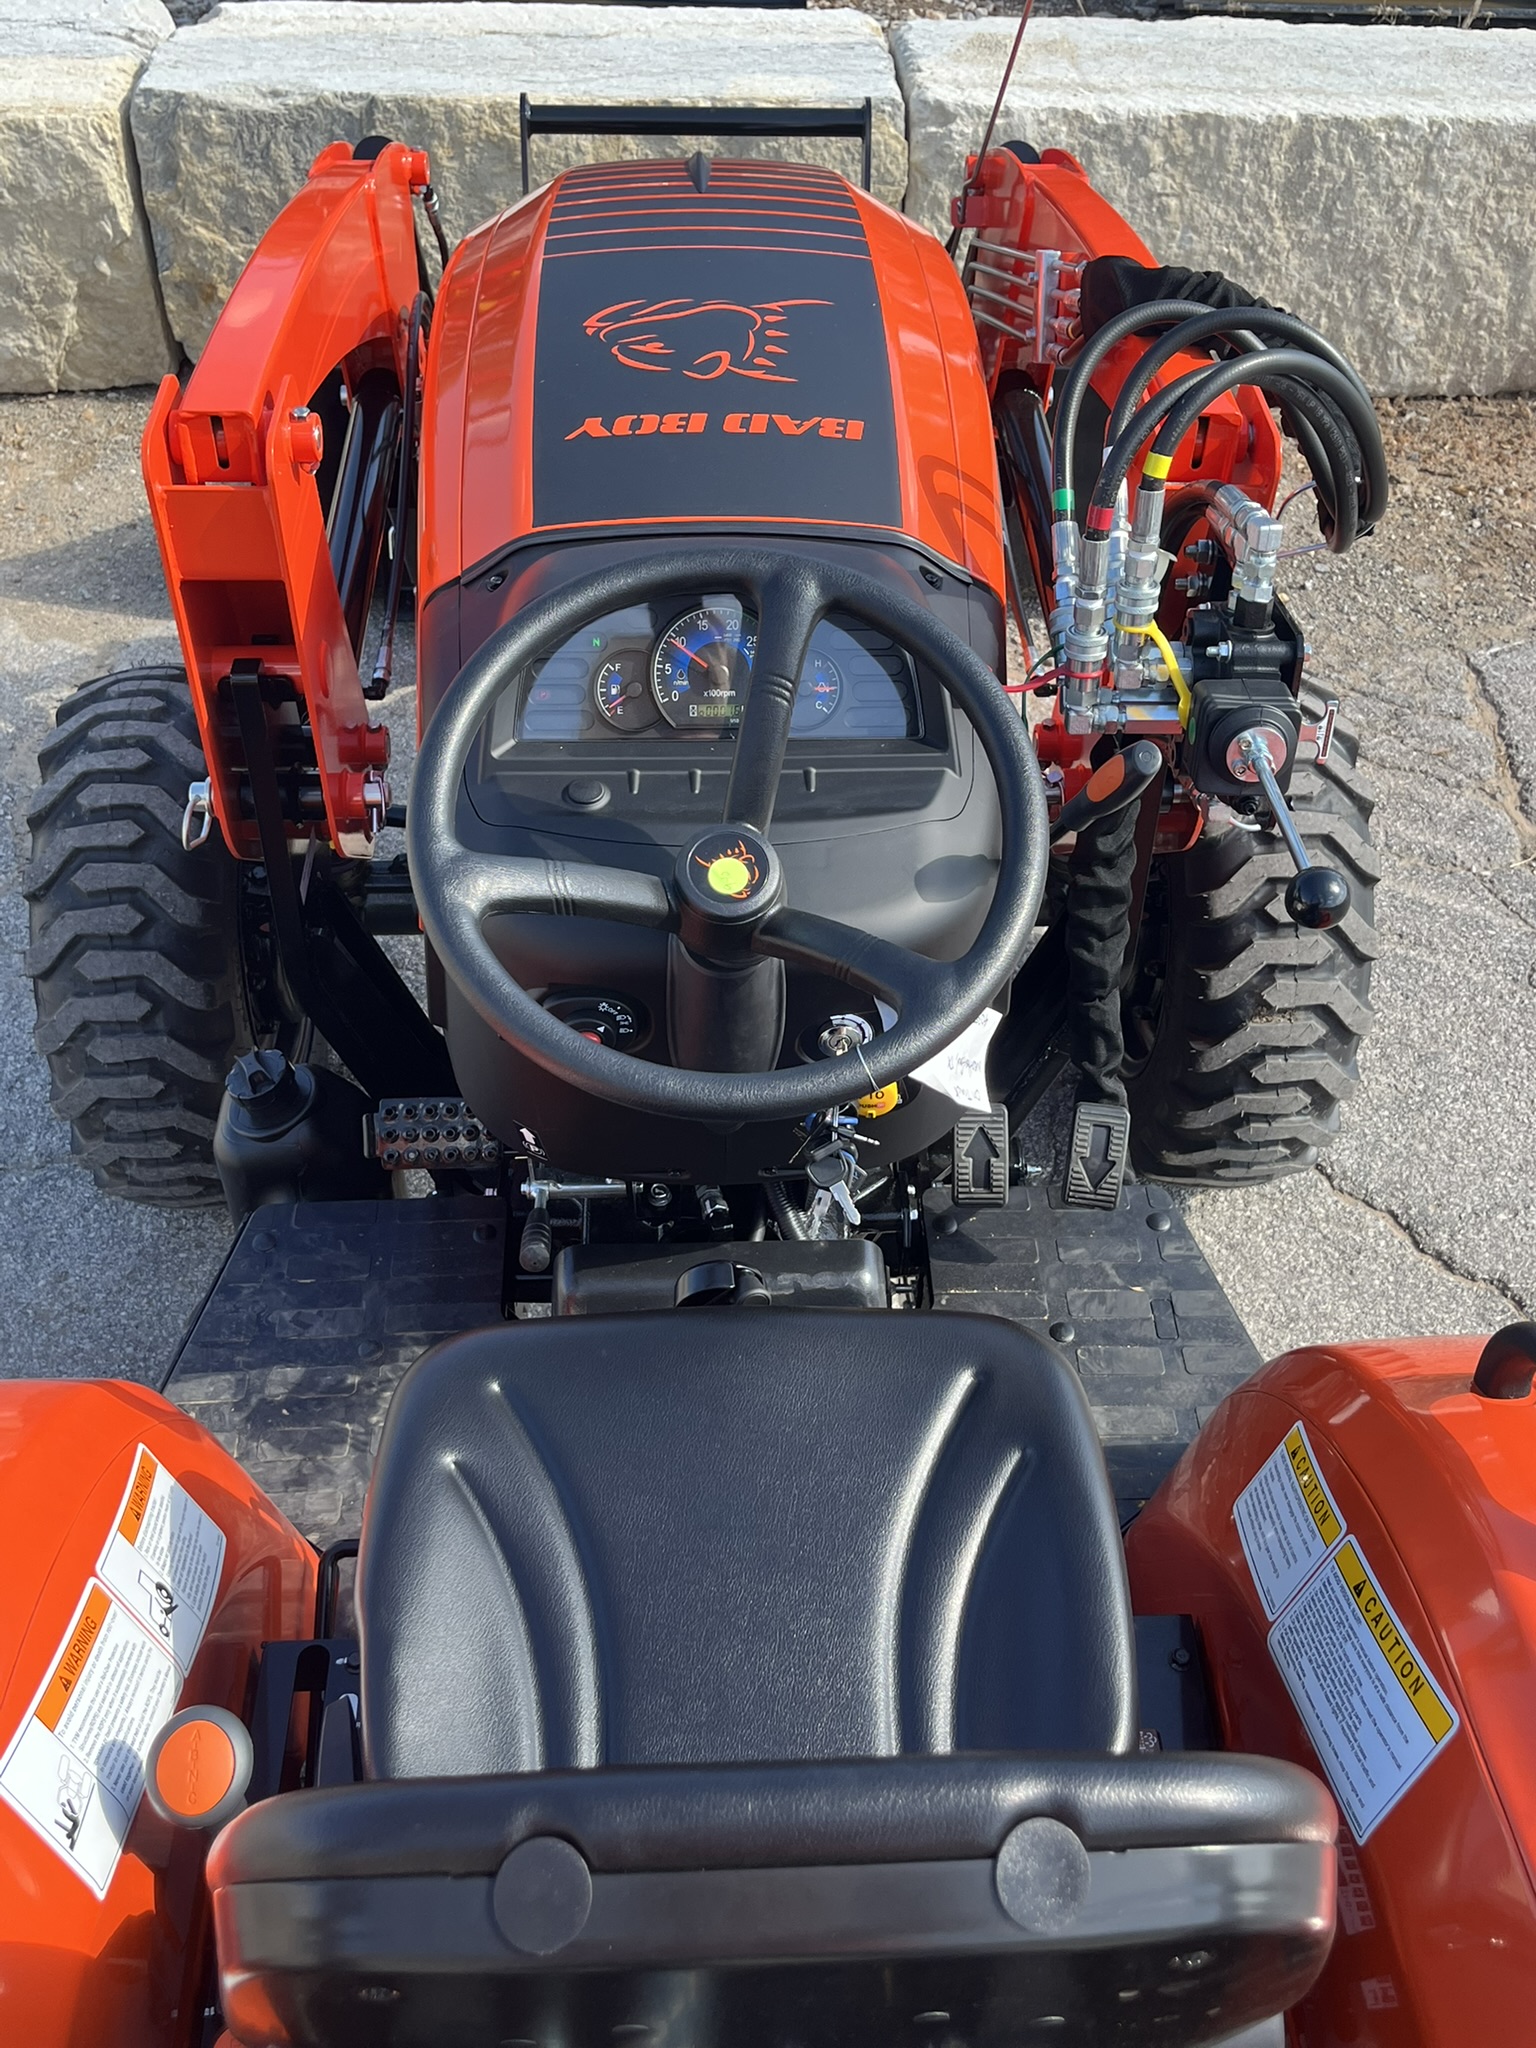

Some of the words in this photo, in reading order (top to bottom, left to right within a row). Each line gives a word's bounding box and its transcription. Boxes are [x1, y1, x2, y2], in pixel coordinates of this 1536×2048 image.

[564, 412, 708, 440] BOY
[723, 413, 865, 441] BAD
[696, 619, 709, 631] 15
[726, 619, 739, 631] 20
[592, 638, 601, 647] N
[615, 663, 622, 672] F
[664, 664, 672, 675] 5
[814, 660, 822, 668] H
[671, 689, 679, 701] 0
[616, 706, 624, 715] E
[815, 701, 823, 709] C
[130, 1463, 152, 1513] WARNING
[1295, 1454, 1330, 1527] CAUTION
[62, 1613, 98, 1679] WARNING
[1362, 1594, 1426, 1697] CAUTION
